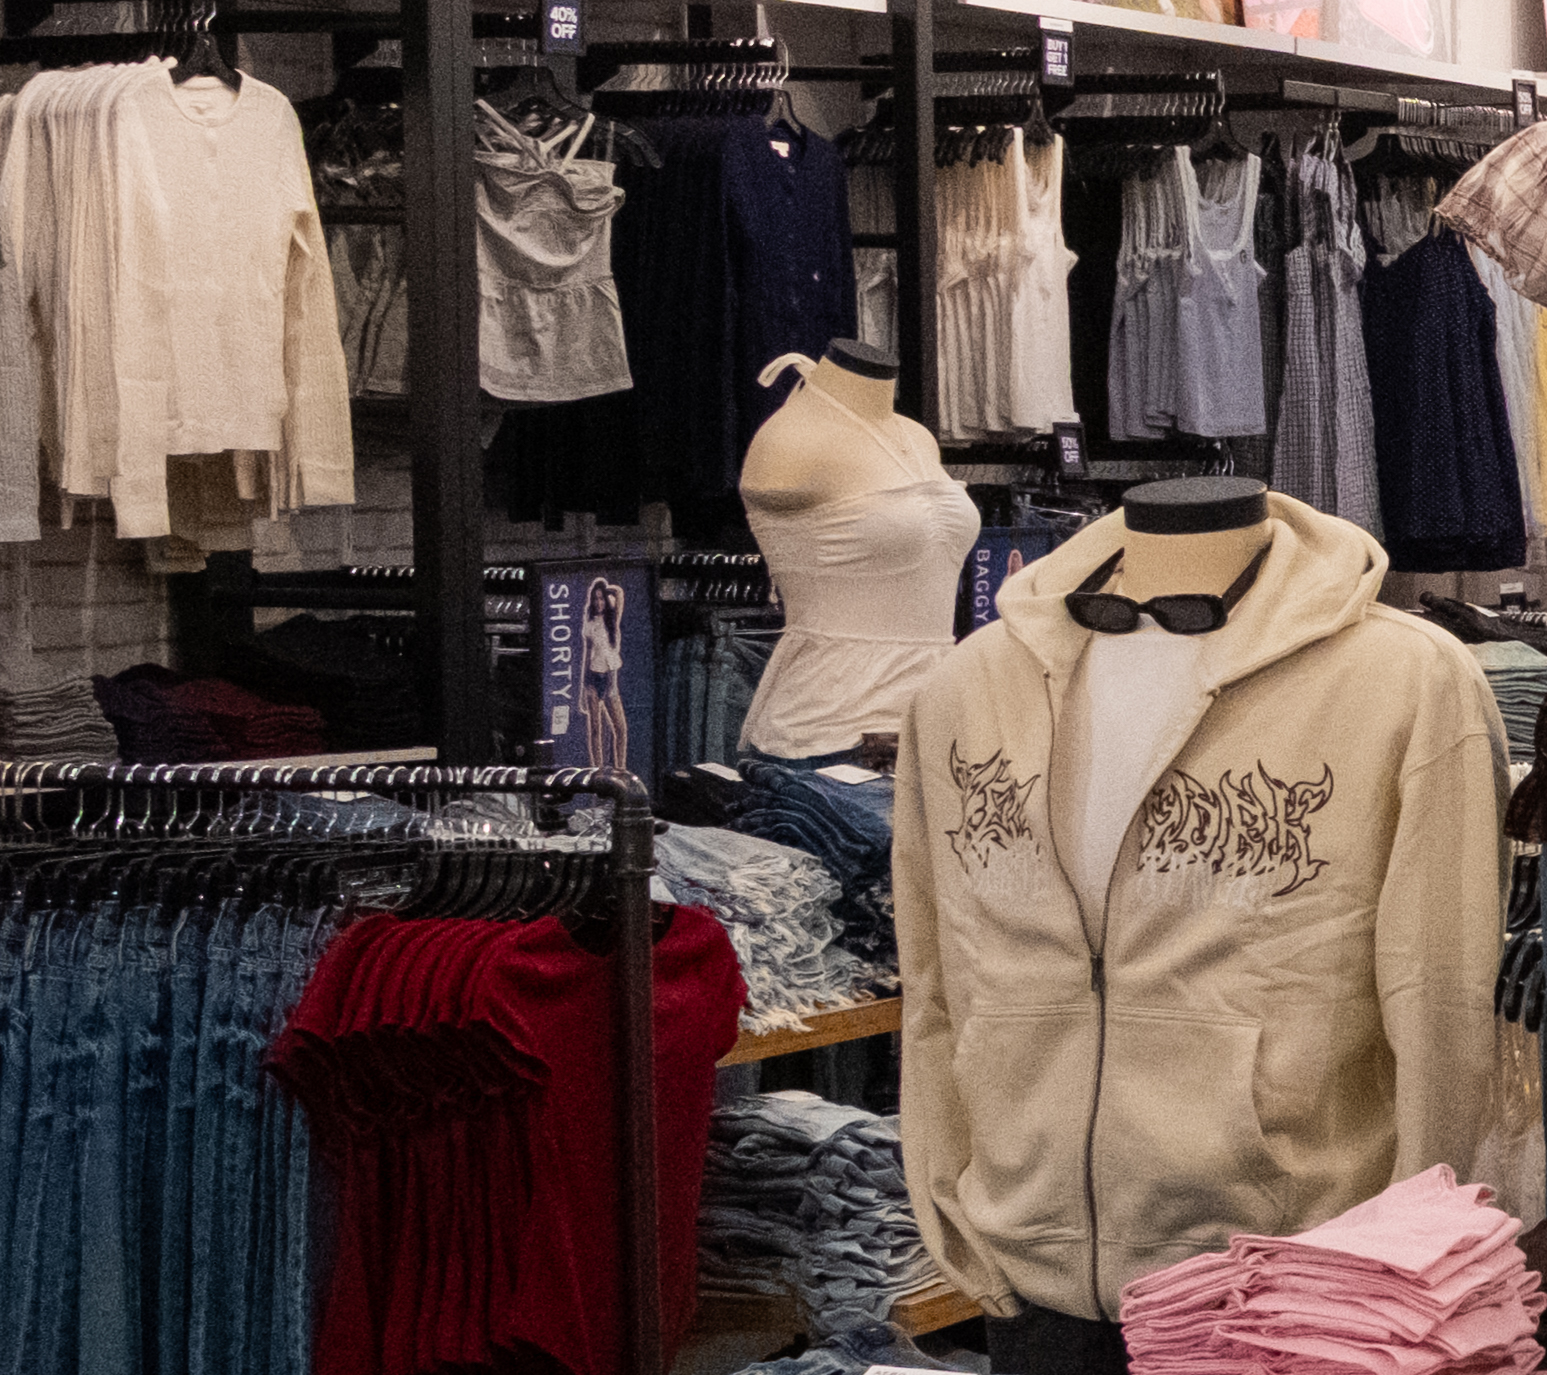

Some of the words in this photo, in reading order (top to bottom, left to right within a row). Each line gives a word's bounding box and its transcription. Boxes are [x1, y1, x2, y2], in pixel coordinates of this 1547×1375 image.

[550, 6, 578, 23] 40%
[551, 23, 577, 40] OFF
[1046, 38, 1063, 51] BUY
[1046, 51, 1062, 64] GET
[1047, 64, 1068, 77] FREE
[975, 549, 991, 622] BAGGY
[549, 583, 572, 699] SHORTY
